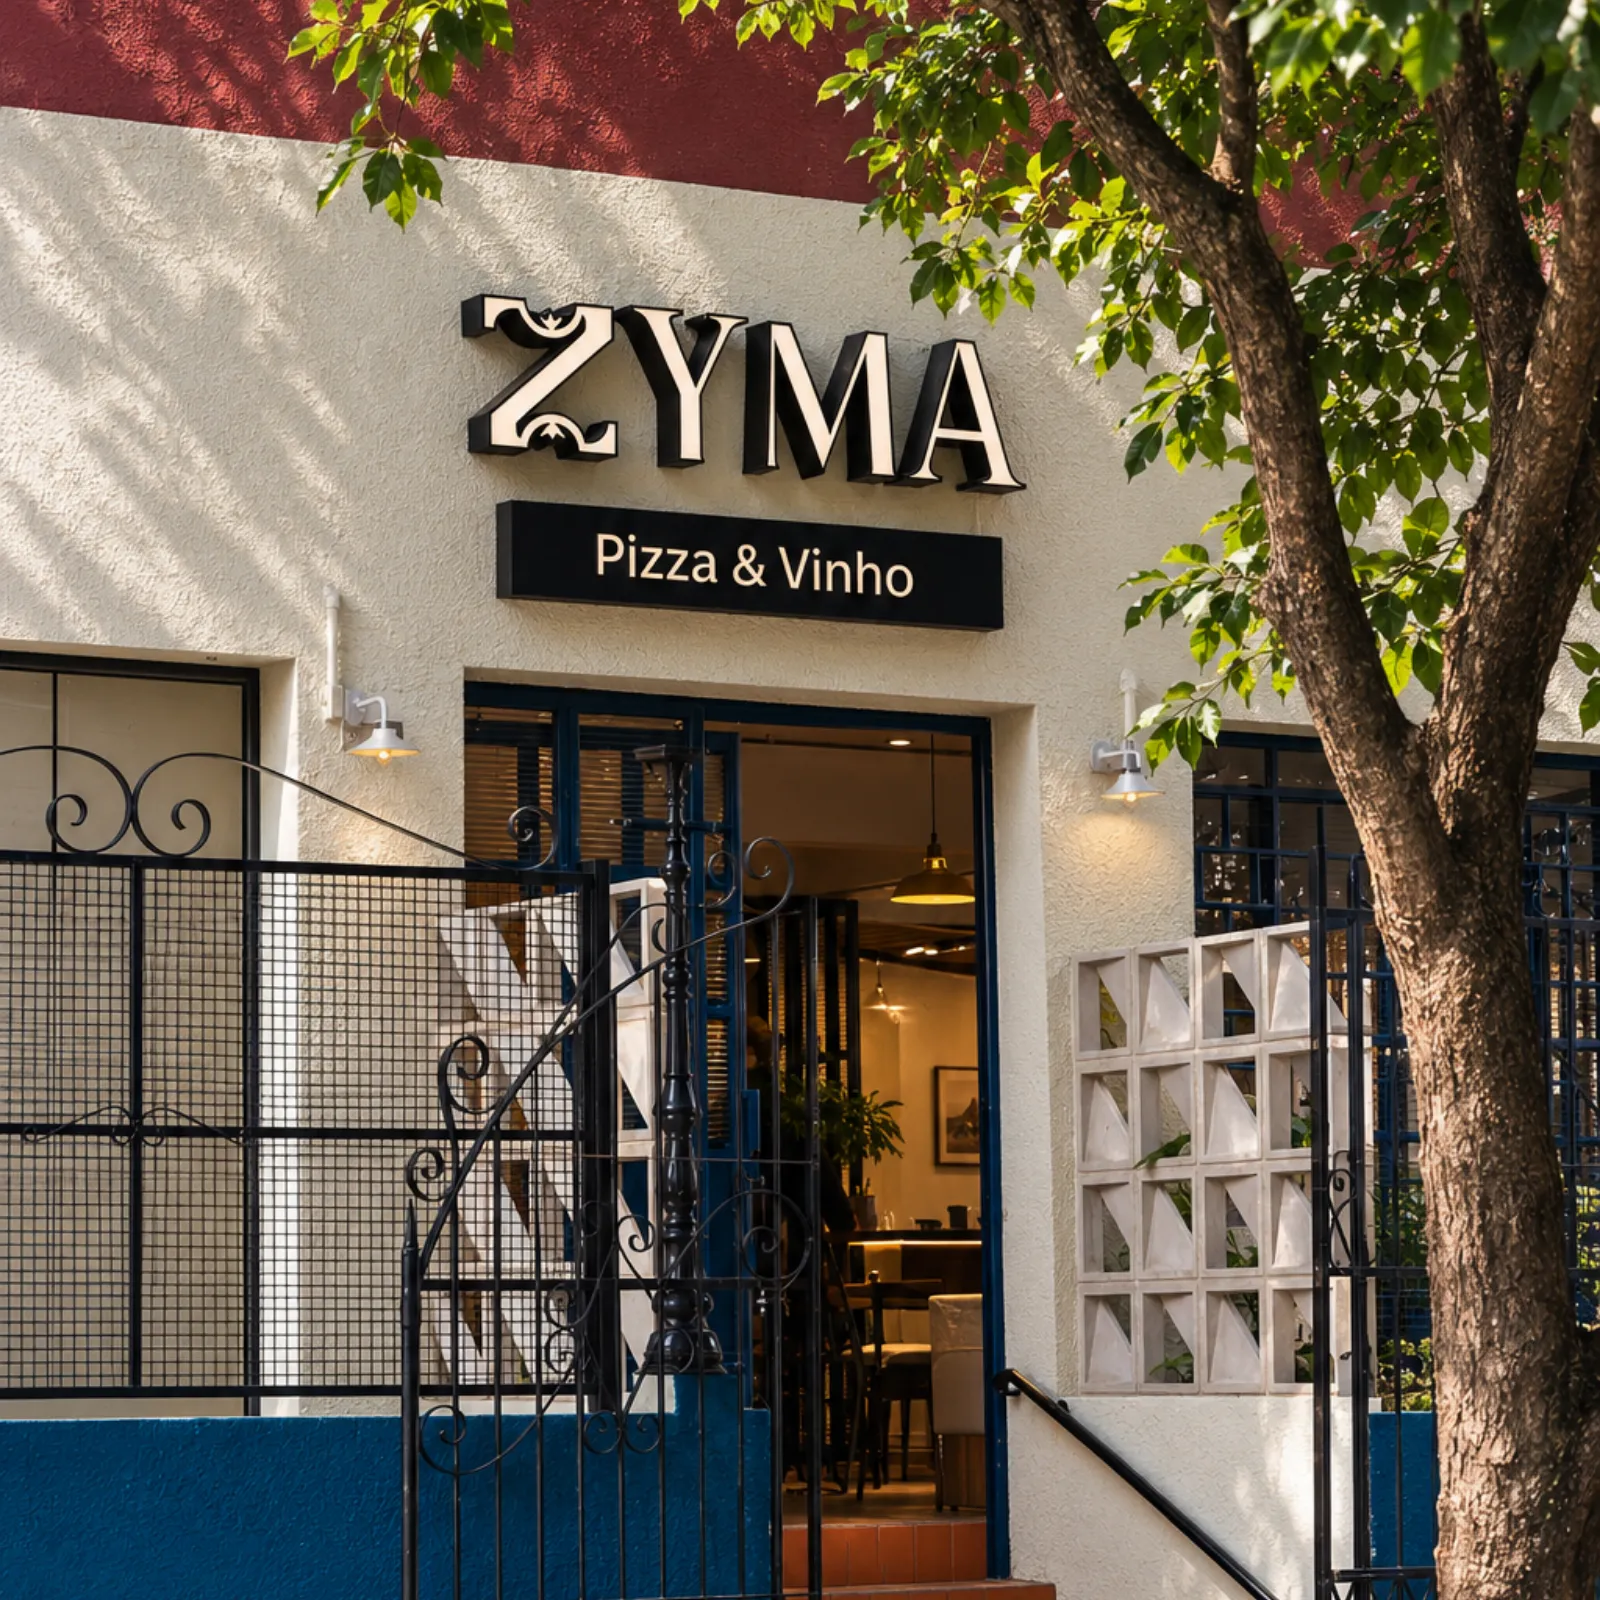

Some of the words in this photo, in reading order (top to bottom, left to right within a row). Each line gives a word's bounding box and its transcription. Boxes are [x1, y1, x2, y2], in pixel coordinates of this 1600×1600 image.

[463, 294, 1026, 493] ZYMA
[596, 533, 718, 583] Pizza
[732, 544, 766, 588] &
[778, 546, 914, 598] Vinho
